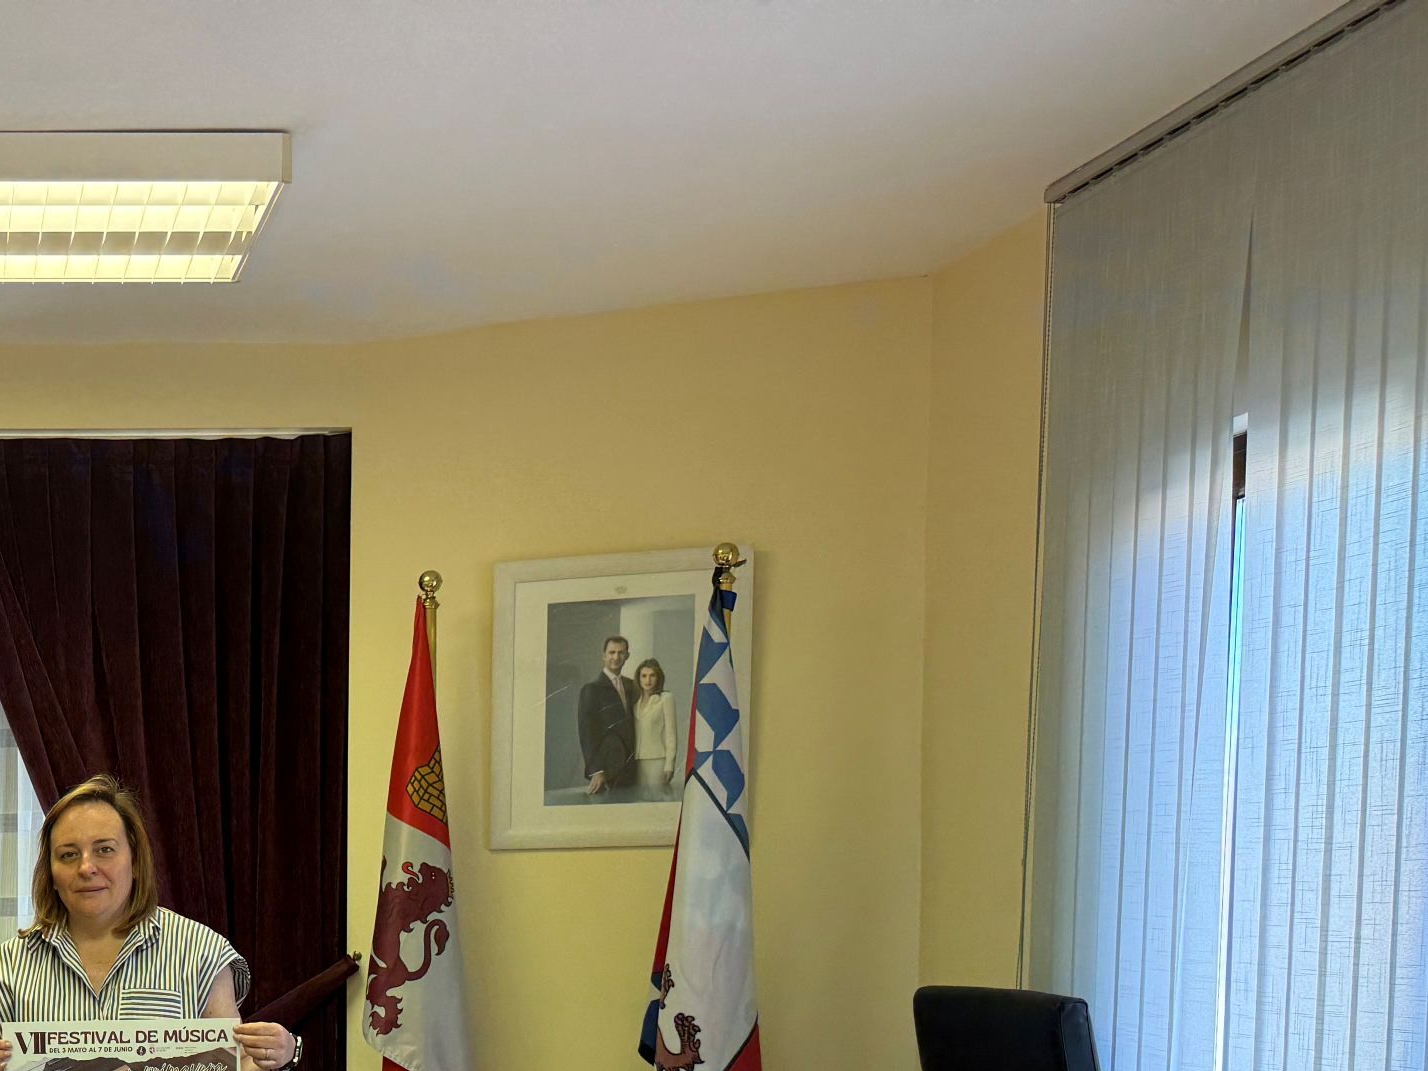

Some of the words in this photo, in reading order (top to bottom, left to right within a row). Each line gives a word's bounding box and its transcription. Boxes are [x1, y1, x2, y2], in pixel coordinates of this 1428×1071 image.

[15, 1031, 48, 1055] VII
[47, 1030, 131, 1045] FESTIVAL
[135, 1031, 158, 1044] DE
[164, 1025, 228, 1044] MÚSICA
